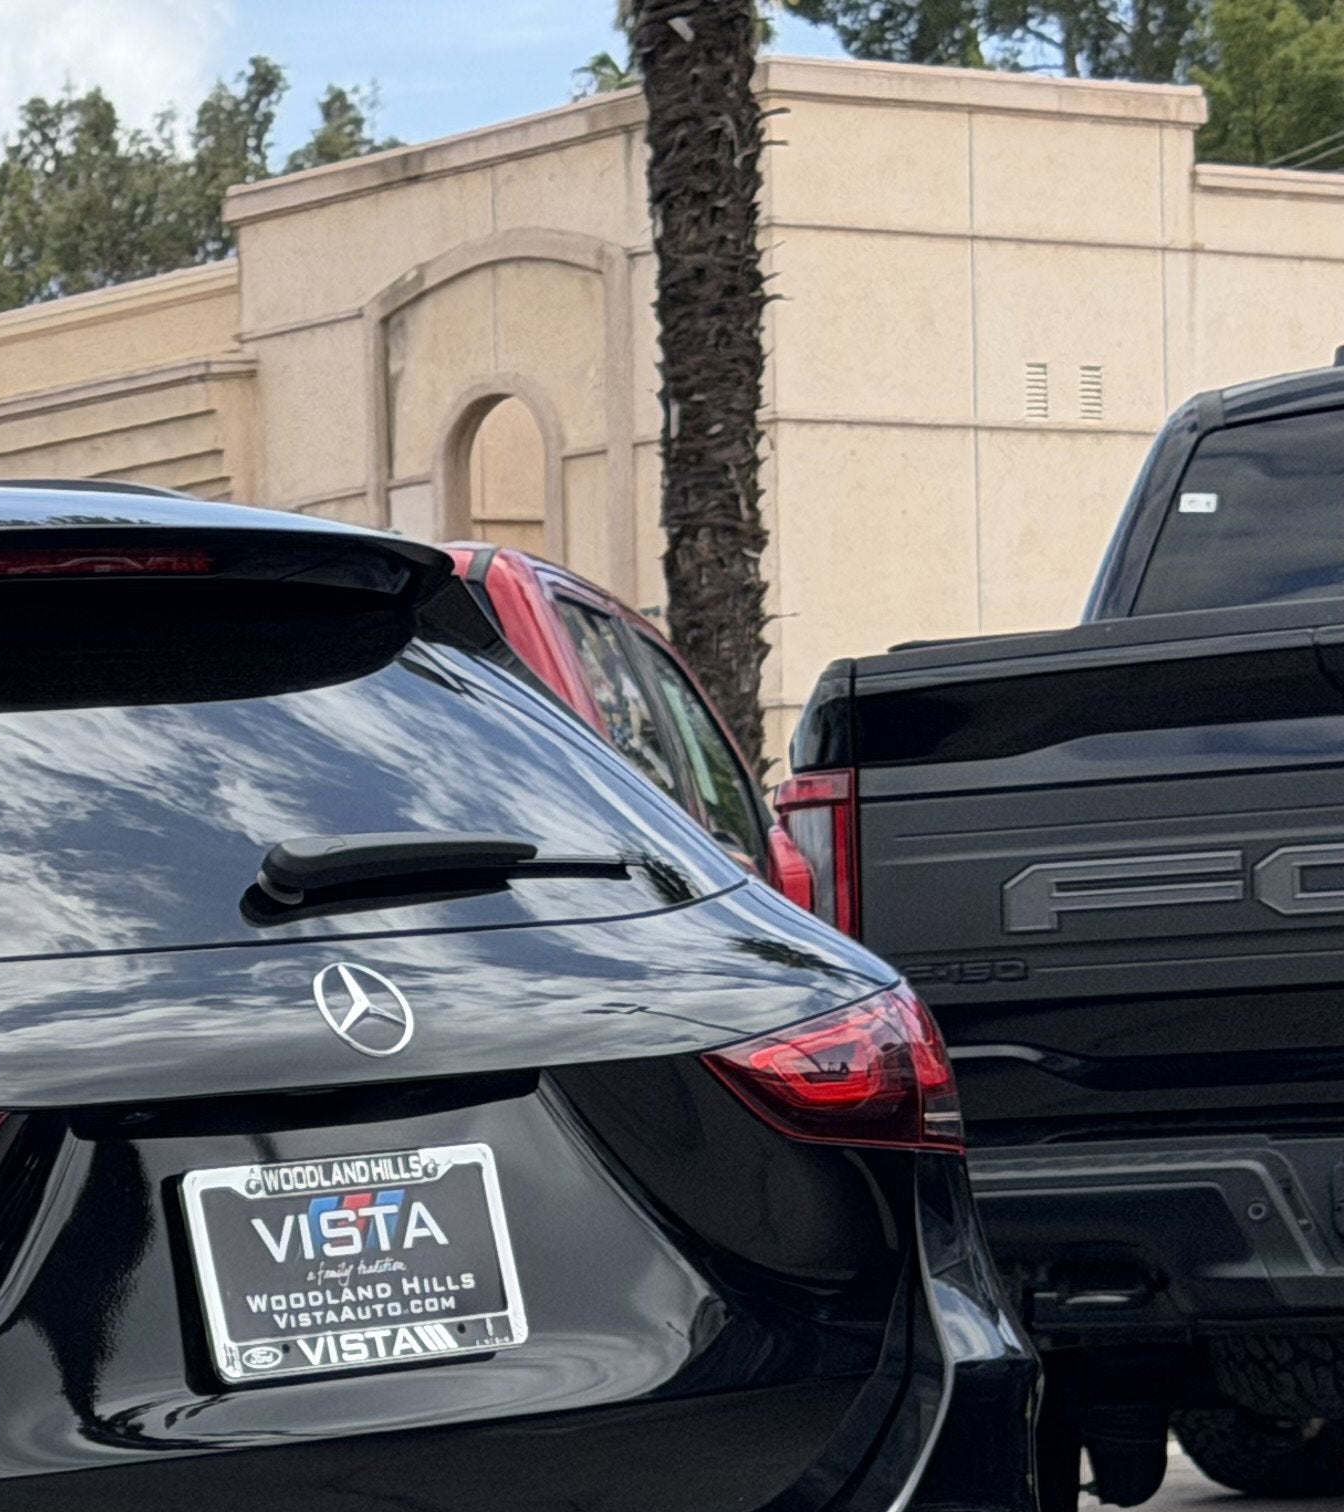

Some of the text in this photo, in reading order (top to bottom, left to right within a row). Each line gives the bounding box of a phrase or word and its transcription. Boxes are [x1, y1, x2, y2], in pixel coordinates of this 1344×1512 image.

[262, 1155, 423, 1192] WOODLAND HILLS
[250, 1201, 449, 1263] VISTA
[246, 1273, 476, 1313] WOODLAND HILLS
[296, 1327, 423, 1366] VISTA
